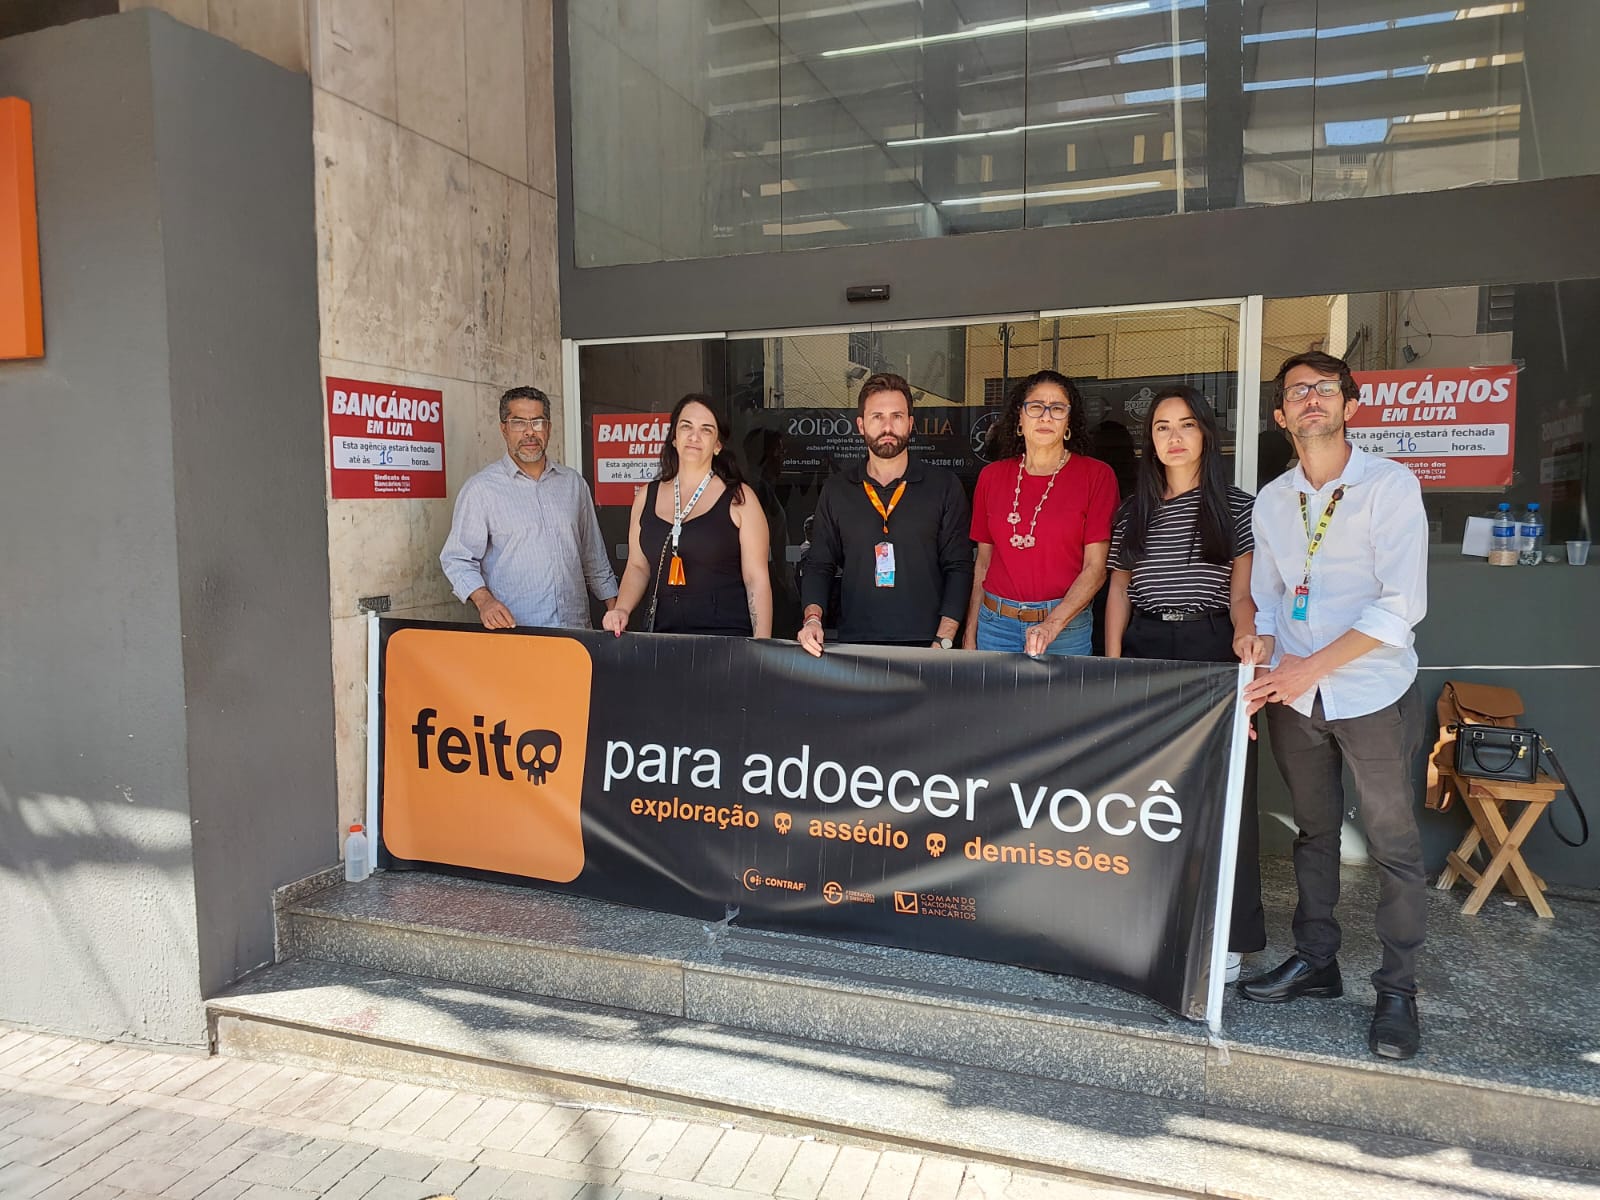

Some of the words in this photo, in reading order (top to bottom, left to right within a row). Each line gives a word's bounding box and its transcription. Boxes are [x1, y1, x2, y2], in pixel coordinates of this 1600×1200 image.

[1358, 374, 1511, 406] ANCÁRIOS
[331, 390, 440, 423] BANCÁRIOS
[1381, 408, 1408, 422] EM
[1412, 406, 1457, 421] LUTA
[366, 419, 383, 435] EM
[386, 421, 413, 436] LUTA
[598, 418, 671, 442] BANCÁR
[1369, 430, 1411, 441] agência
[1414, 429, 1448, 438] estará
[1451, 428, 1495, 438] fechada
[342, 441, 359, 450] Esta
[360, 442, 387, 452] agência
[388, 444, 409, 452] estará
[410, 445, 435, 454] fechada
[628, 443, 645, 455] EM
[648, 443, 664, 455] LU
[1372, 444, 1384, 453] às
[1396, 438, 1417, 452] 16
[1451, 442, 1486, 451] horas.
[349, 455, 361, 464] até
[362, 455, 371, 464] às
[379, 450, 393, 465] 16
[411, 457, 431, 466] horas.
[622, 460, 648, 469] agência
[611, 471, 622, 479] até
[624, 471, 631, 479] às
[640, 467, 653, 479] 16
[603, 740, 721, 792] para
[741, 744, 989, 822] adoecer
[1009, 779, 1183, 843] você
[630, 797, 760, 831] exploração
[808, 819, 909, 850] assédio
[963, 836, 1130, 876] demissões
[765, 877, 804, 891] CONTRAF
[920, 893, 976, 905] COMANDO
[921, 901, 959, 910] NACIONAL
[960, 904, 976, 912] DOS
